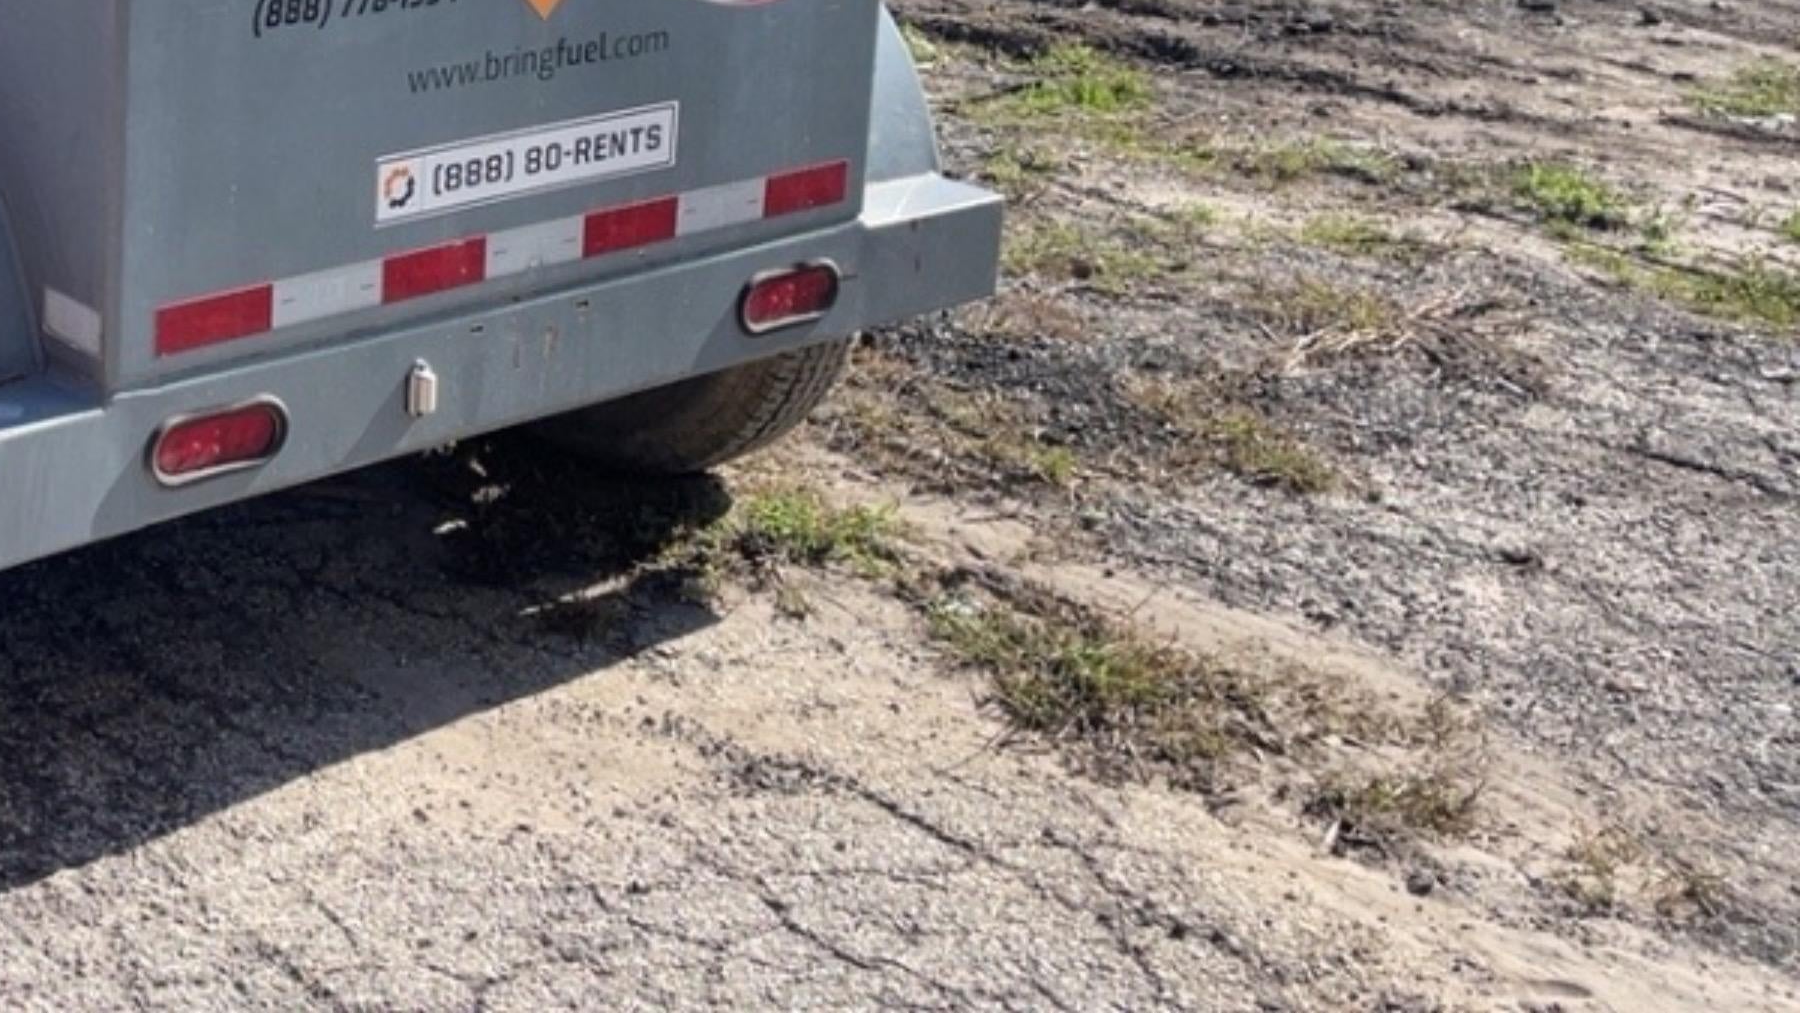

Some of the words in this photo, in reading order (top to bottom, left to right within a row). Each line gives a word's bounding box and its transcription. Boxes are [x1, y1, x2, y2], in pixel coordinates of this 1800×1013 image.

[407, 28, 670, 94] www.bringfuel.com
[431, 149, 515, 197] (888)
[524, 124, 663, 173] 80-RENTS
